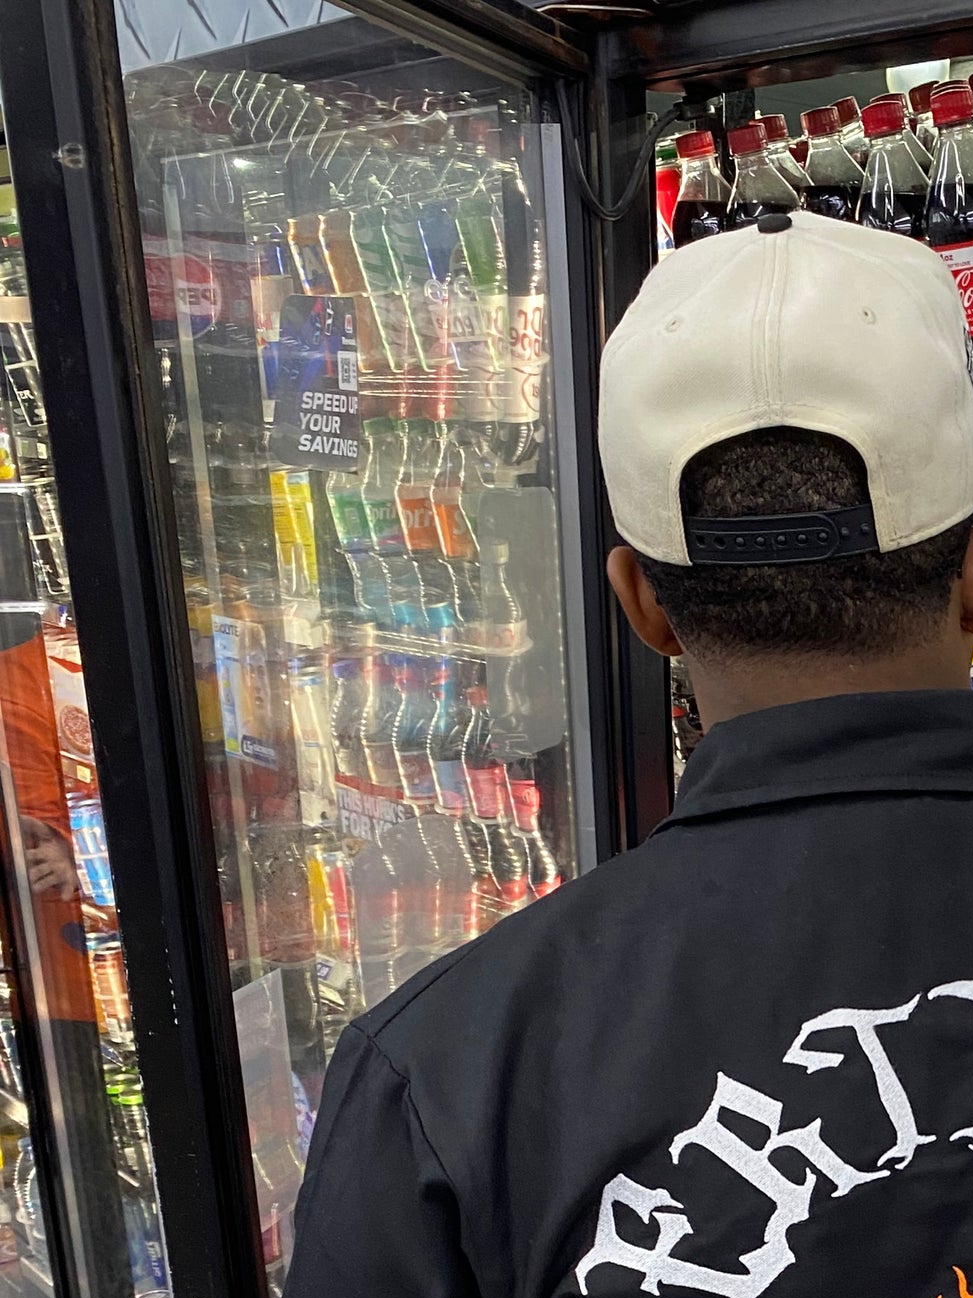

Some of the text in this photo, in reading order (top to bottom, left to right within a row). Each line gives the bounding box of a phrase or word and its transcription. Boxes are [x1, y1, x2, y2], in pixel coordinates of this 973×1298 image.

[302, 391, 346, 413] SPEED
[299, 413, 341, 434] YOUR
[298, 434, 358, 458] SAVINGS
